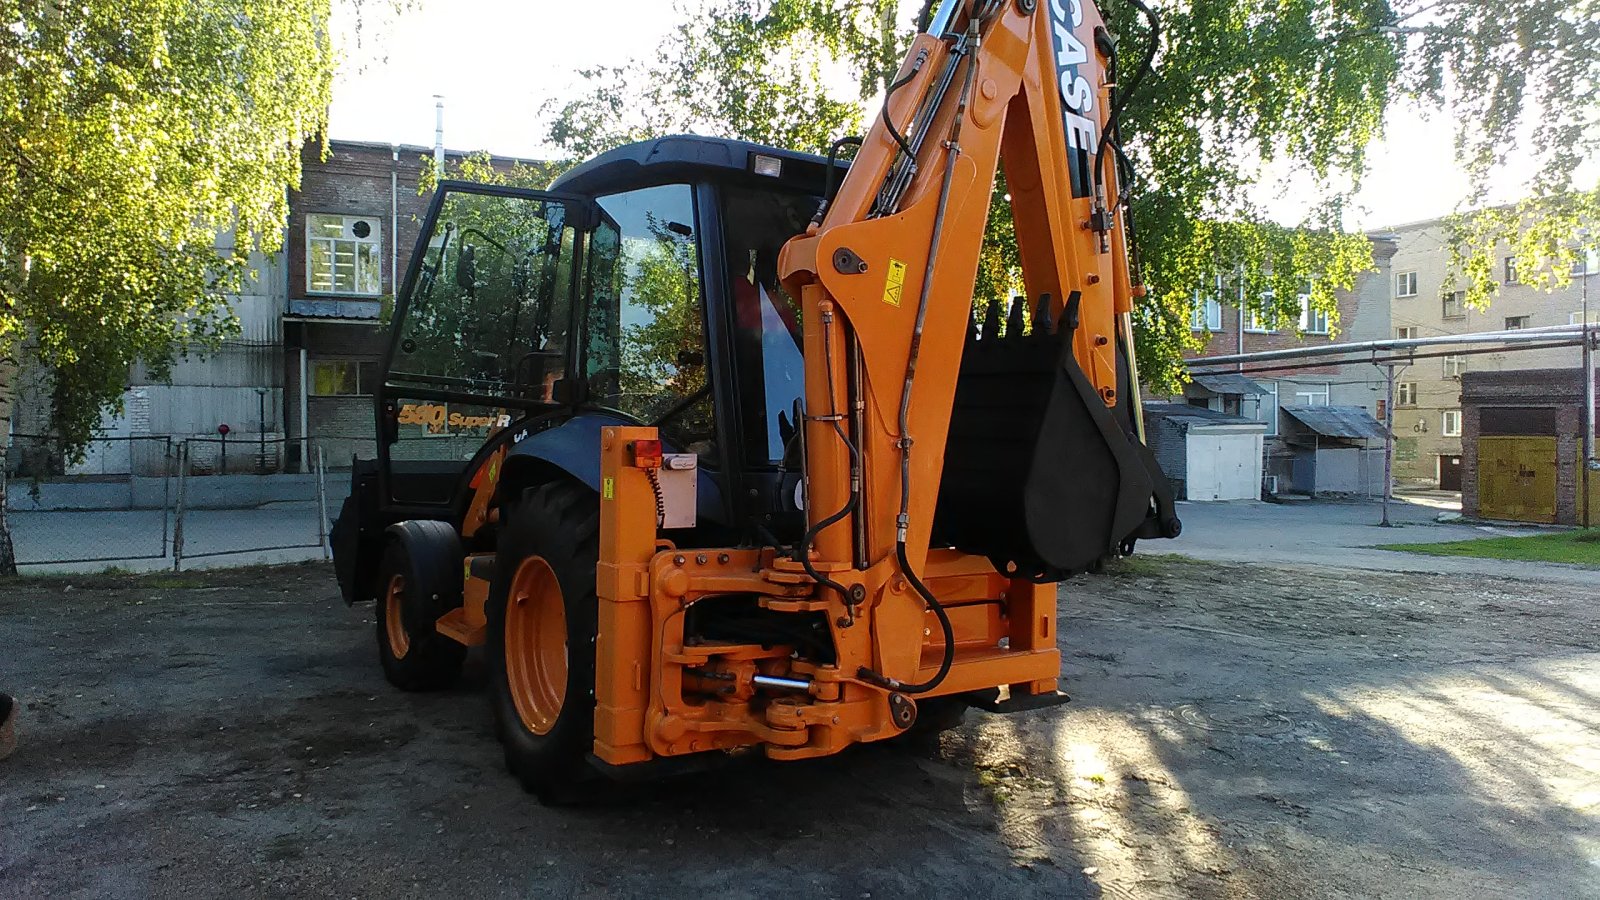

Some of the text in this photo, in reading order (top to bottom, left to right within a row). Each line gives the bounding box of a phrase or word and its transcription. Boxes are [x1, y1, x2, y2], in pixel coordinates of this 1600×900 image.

[1052, 0, 1098, 155] CASE
[448, 412, 497, 428] Super
[497, 414, 511, 427] R
